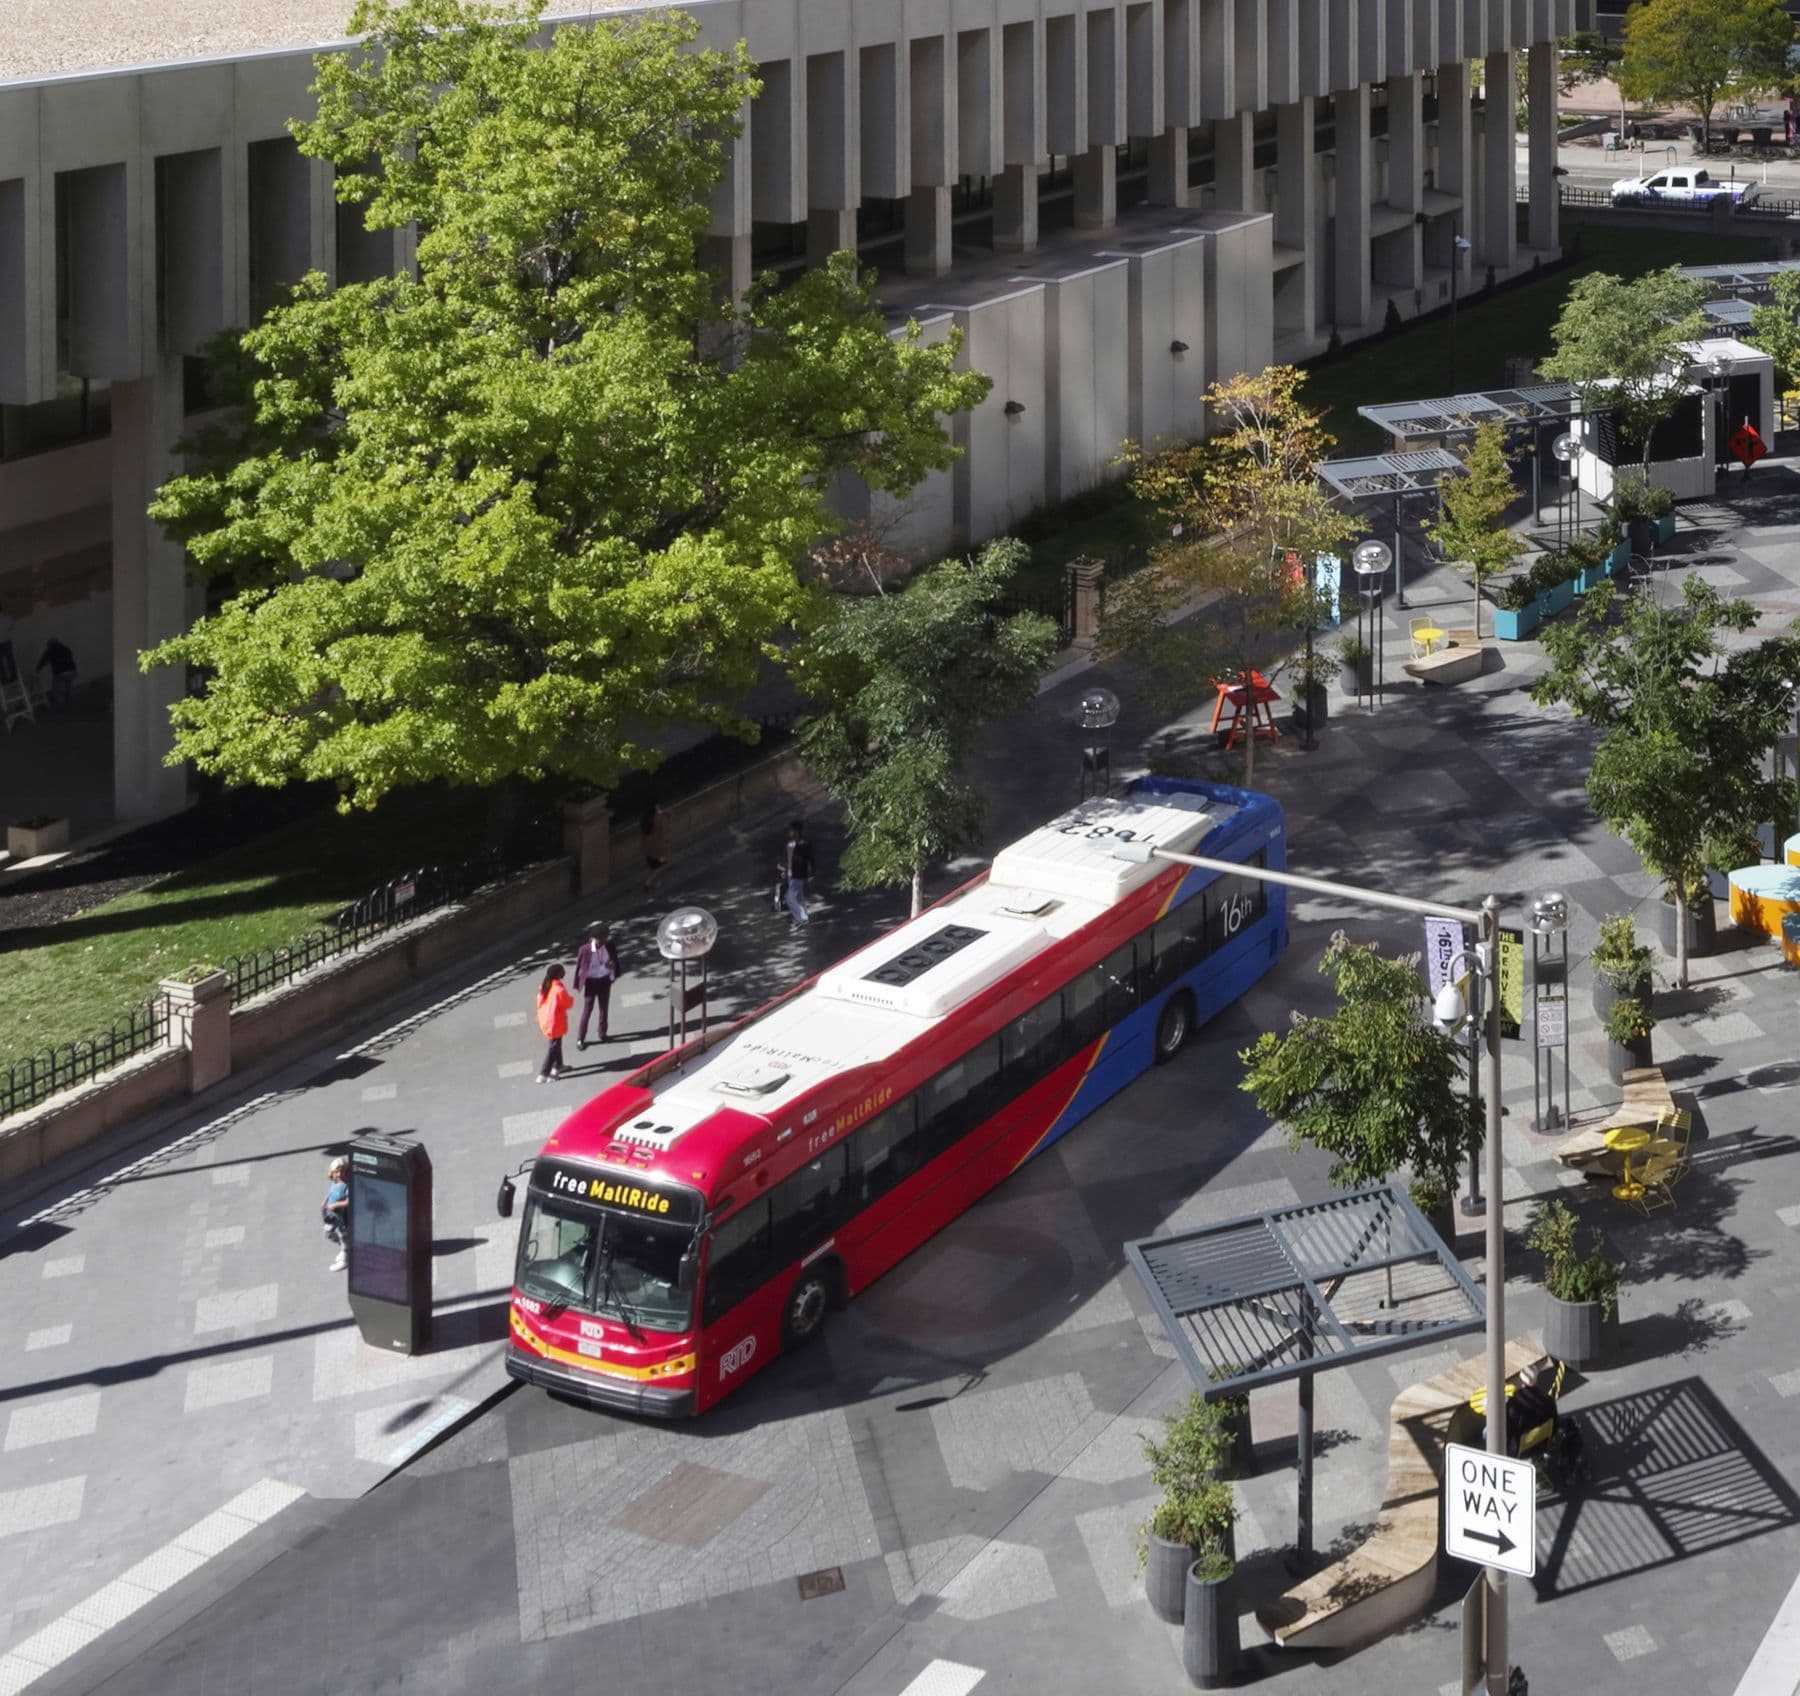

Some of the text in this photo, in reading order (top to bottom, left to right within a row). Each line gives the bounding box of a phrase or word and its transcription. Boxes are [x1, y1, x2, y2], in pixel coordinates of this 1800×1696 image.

[1221, 893, 1253, 936] 16th
[553, 1171, 669, 1212] free MallRide
[580, 1320, 604, 1339] RTD
[720, 1336, 757, 1381] RTD
[1462, 1460, 1516, 1495] ONE
[1463, 1489, 1518, 1524] WAY
